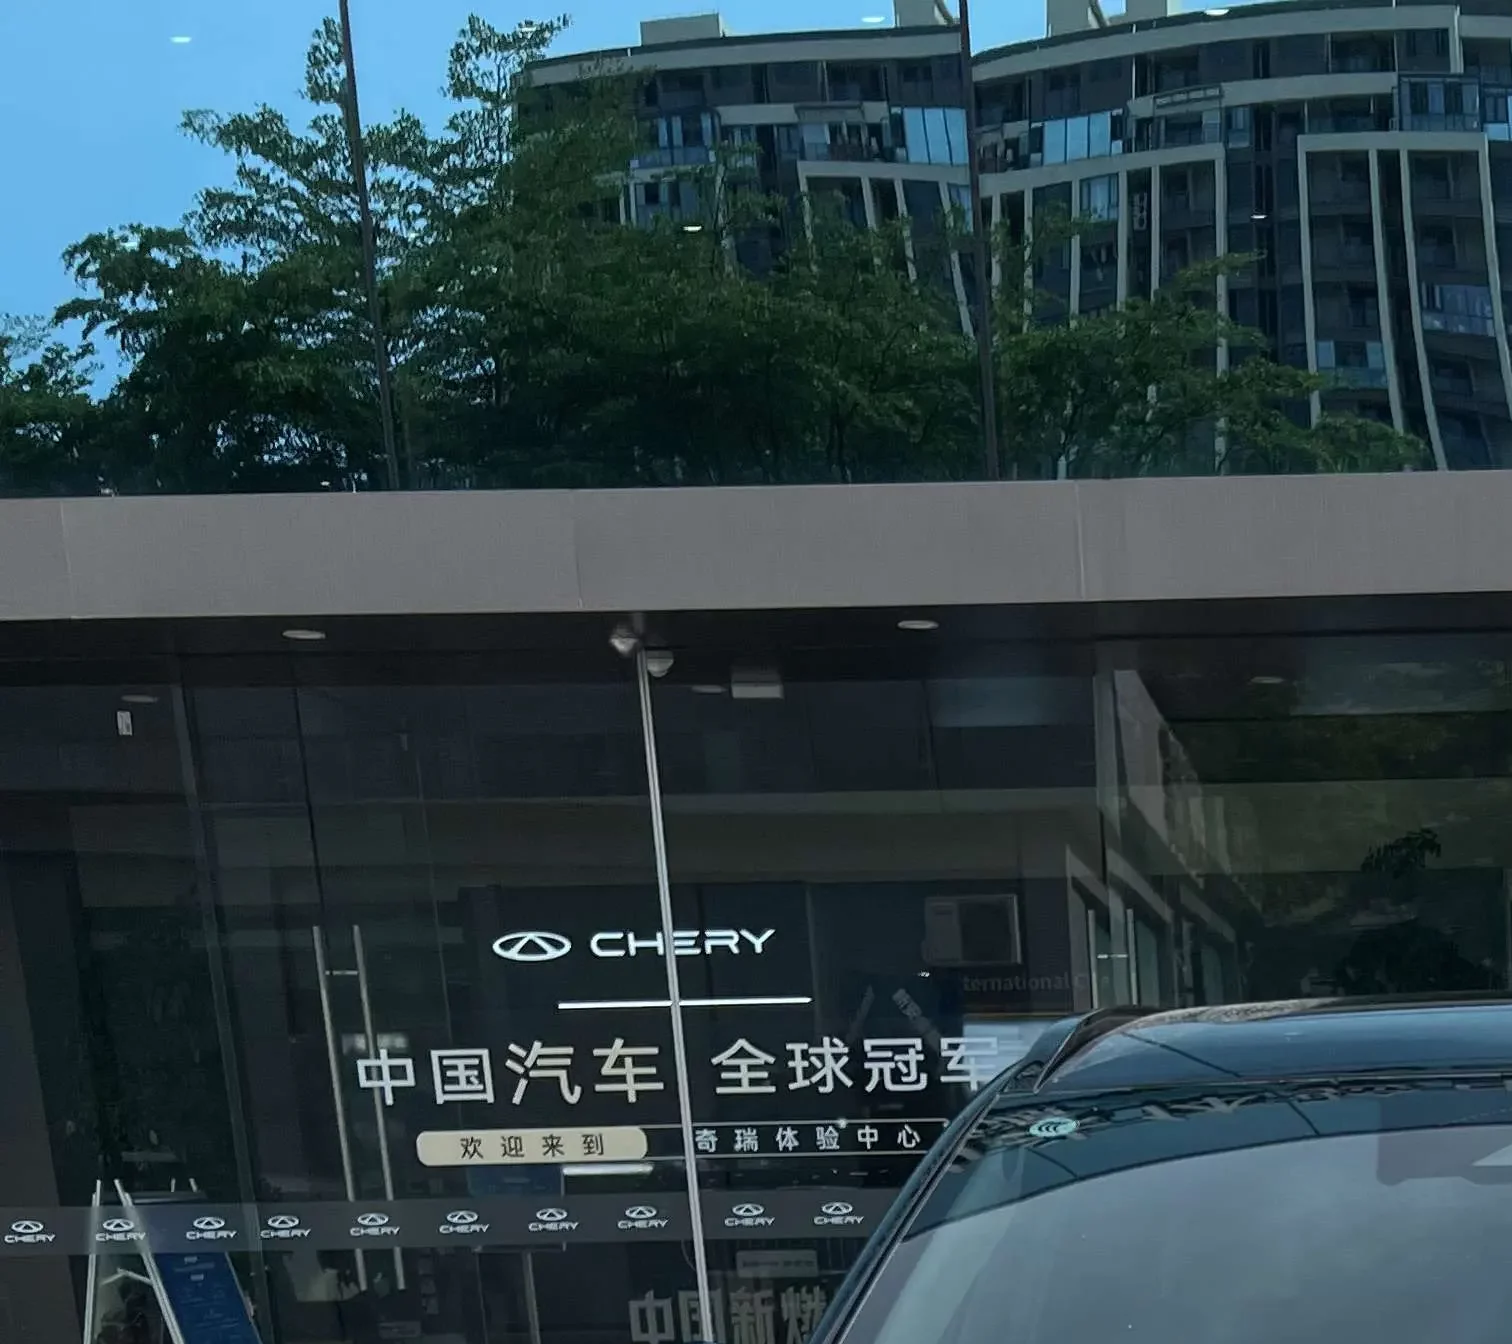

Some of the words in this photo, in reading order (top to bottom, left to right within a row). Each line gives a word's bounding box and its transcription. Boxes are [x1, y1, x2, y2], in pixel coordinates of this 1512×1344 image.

[590, 928, 776, 957] CHERY
[356, 1037, 665, 1106] 中国汽车
[710, 1036, 999, 1094] 全球冠军
[459, 1133, 605, 1160] 欢迎来到
[695, 1123, 921, 1153] 奇瑞体验中心
[4, 1233, 56, 1244] CHERY
[95, 1231, 147, 1242] CHERY
[186, 1229, 238, 1240] CHERY
[260, 1228, 312, 1239] CHERY
[349, 1226, 401, 1237] CHERY
[439, 1223, 490, 1234] CHERY
[528, 1220, 579, 1232] CHERY
[617, 1218, 669, 1230] CHERY
[724, 1215, 775, 1227] CHERY
[813, 1213, 865, 1225] CHERY
